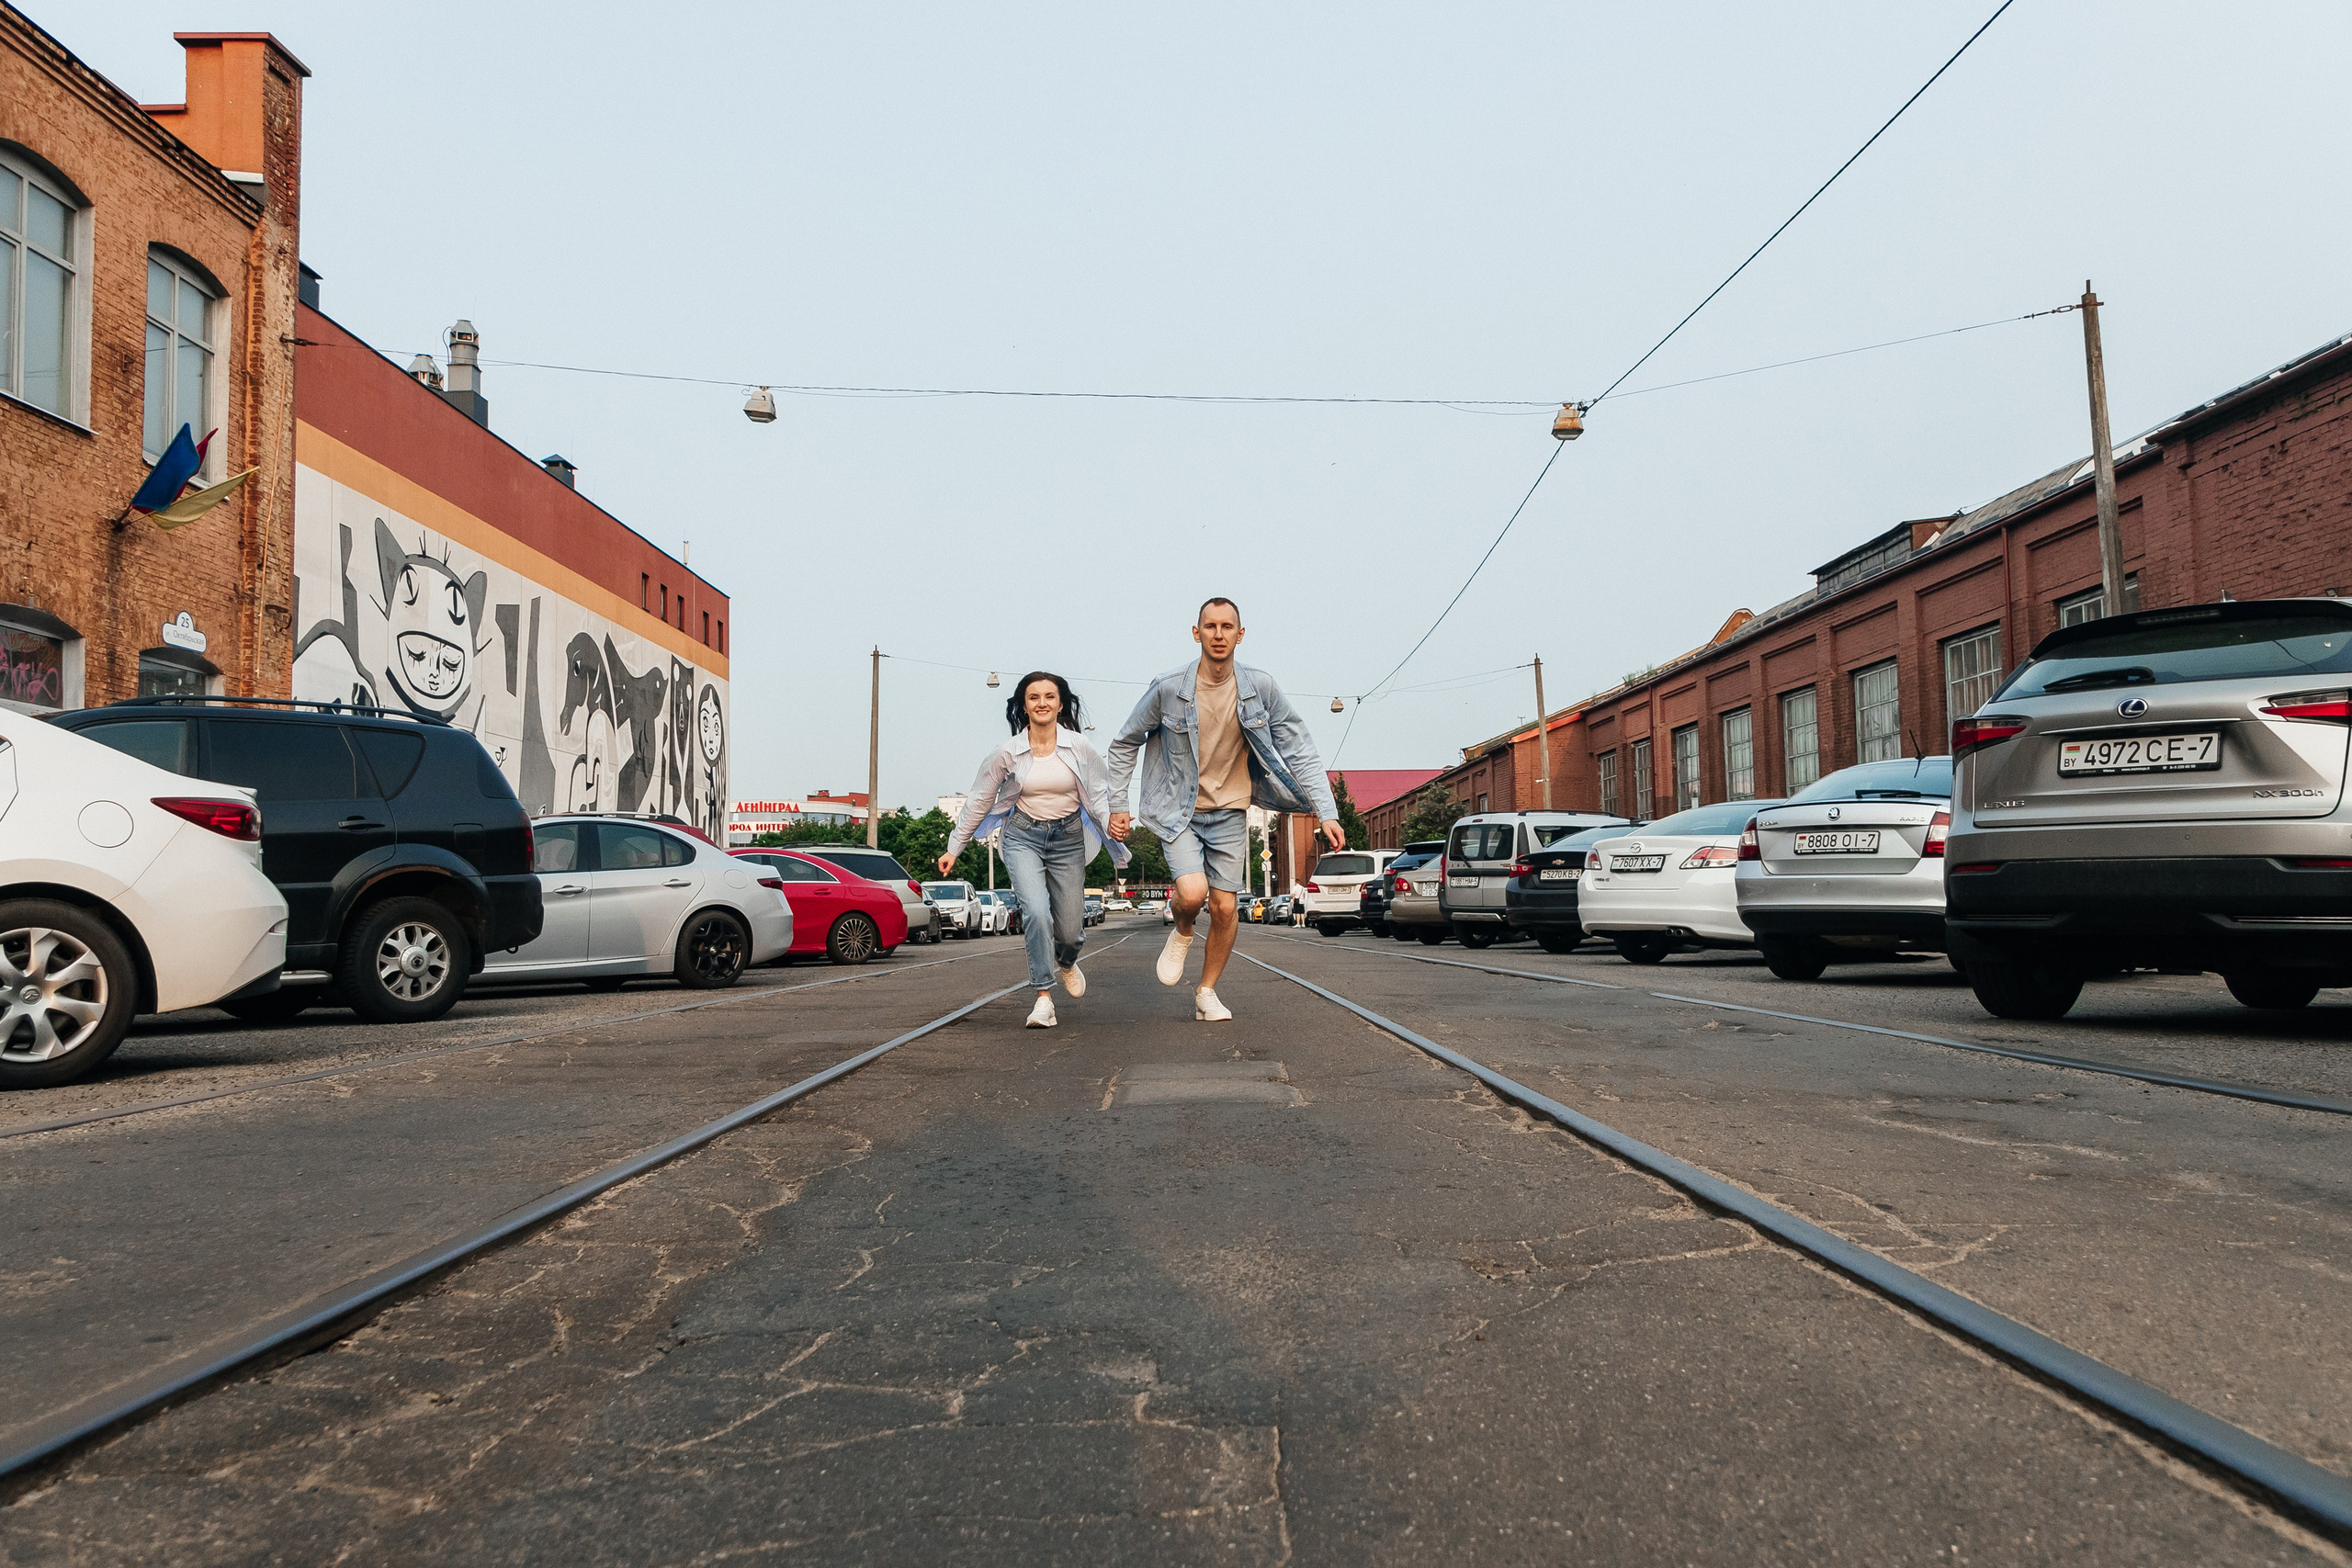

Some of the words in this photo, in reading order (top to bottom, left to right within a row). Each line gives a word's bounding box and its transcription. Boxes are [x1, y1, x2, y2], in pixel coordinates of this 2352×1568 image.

[181, 616, 190, 629] 25
[2064, 758, 2076, 768] BY
[1984, 800, 2025, 809] LEXUS
[1150, 890, 1163, 898] BYN
